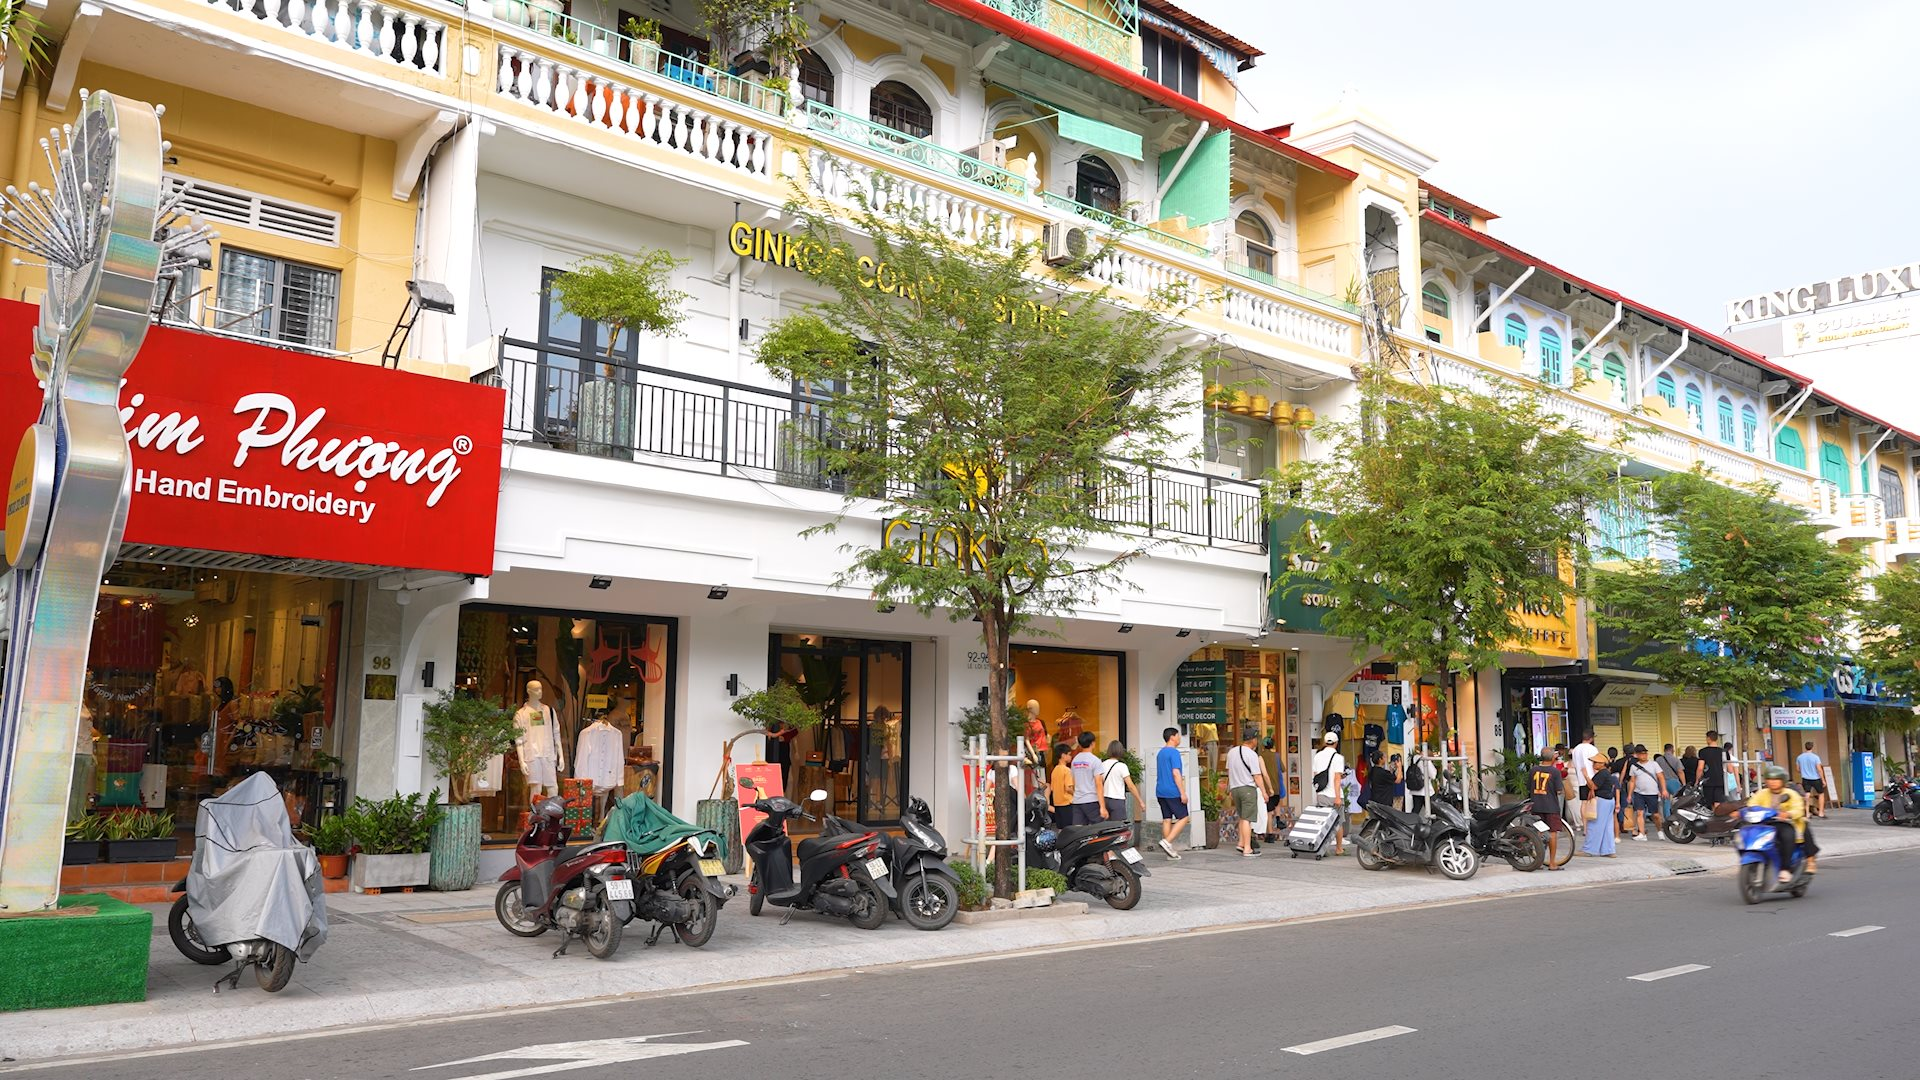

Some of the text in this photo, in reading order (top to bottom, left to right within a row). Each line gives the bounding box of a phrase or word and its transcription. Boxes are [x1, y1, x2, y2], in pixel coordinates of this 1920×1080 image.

[1726, 283, 1819, 326] KING
[119, 378, 205, 455] im
[134, 467, 377, 525] Hand Embroidery
[372, 655, 392, 671] 98
[1797, 716, 1820, 725] 24H
[1533, 771, 1550, 791] 17
